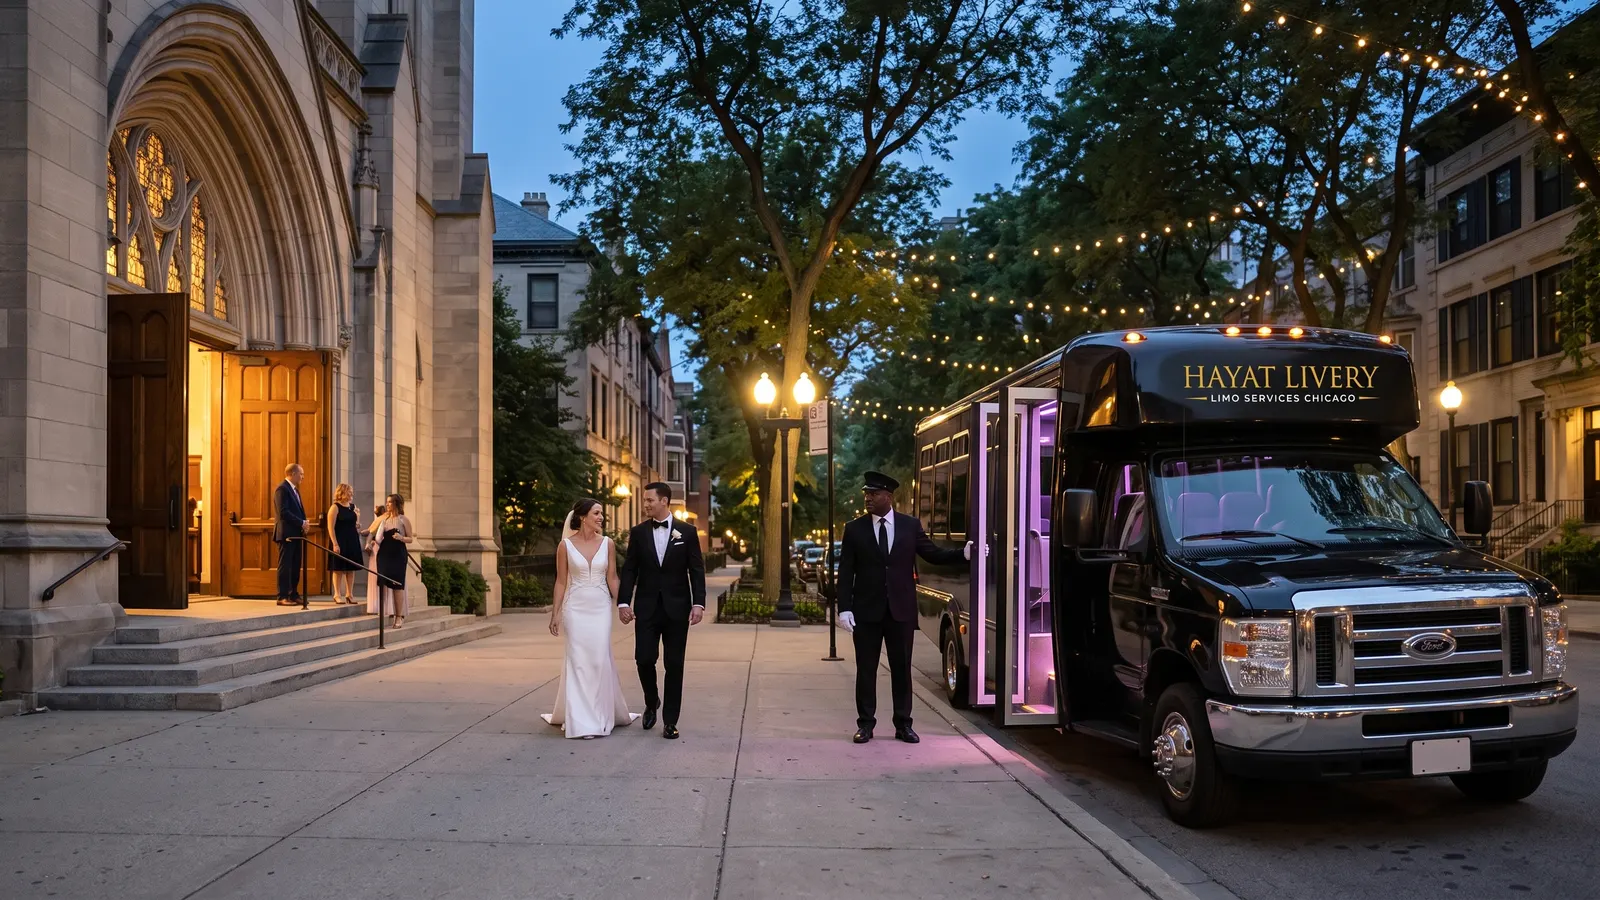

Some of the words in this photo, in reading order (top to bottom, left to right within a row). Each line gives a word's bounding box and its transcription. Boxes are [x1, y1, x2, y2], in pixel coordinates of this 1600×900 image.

[1183, 365, 1276, 388] HAYAT
[1284, 365, 1380, 388] LIVERY
[1211, 394, 1240, 403] LIMO
[1244, 394, 1300, 403] SERVICES
[1304, 394, 1356, 403] CHICAGO
[1421, 640, 1444, 651] Ford
